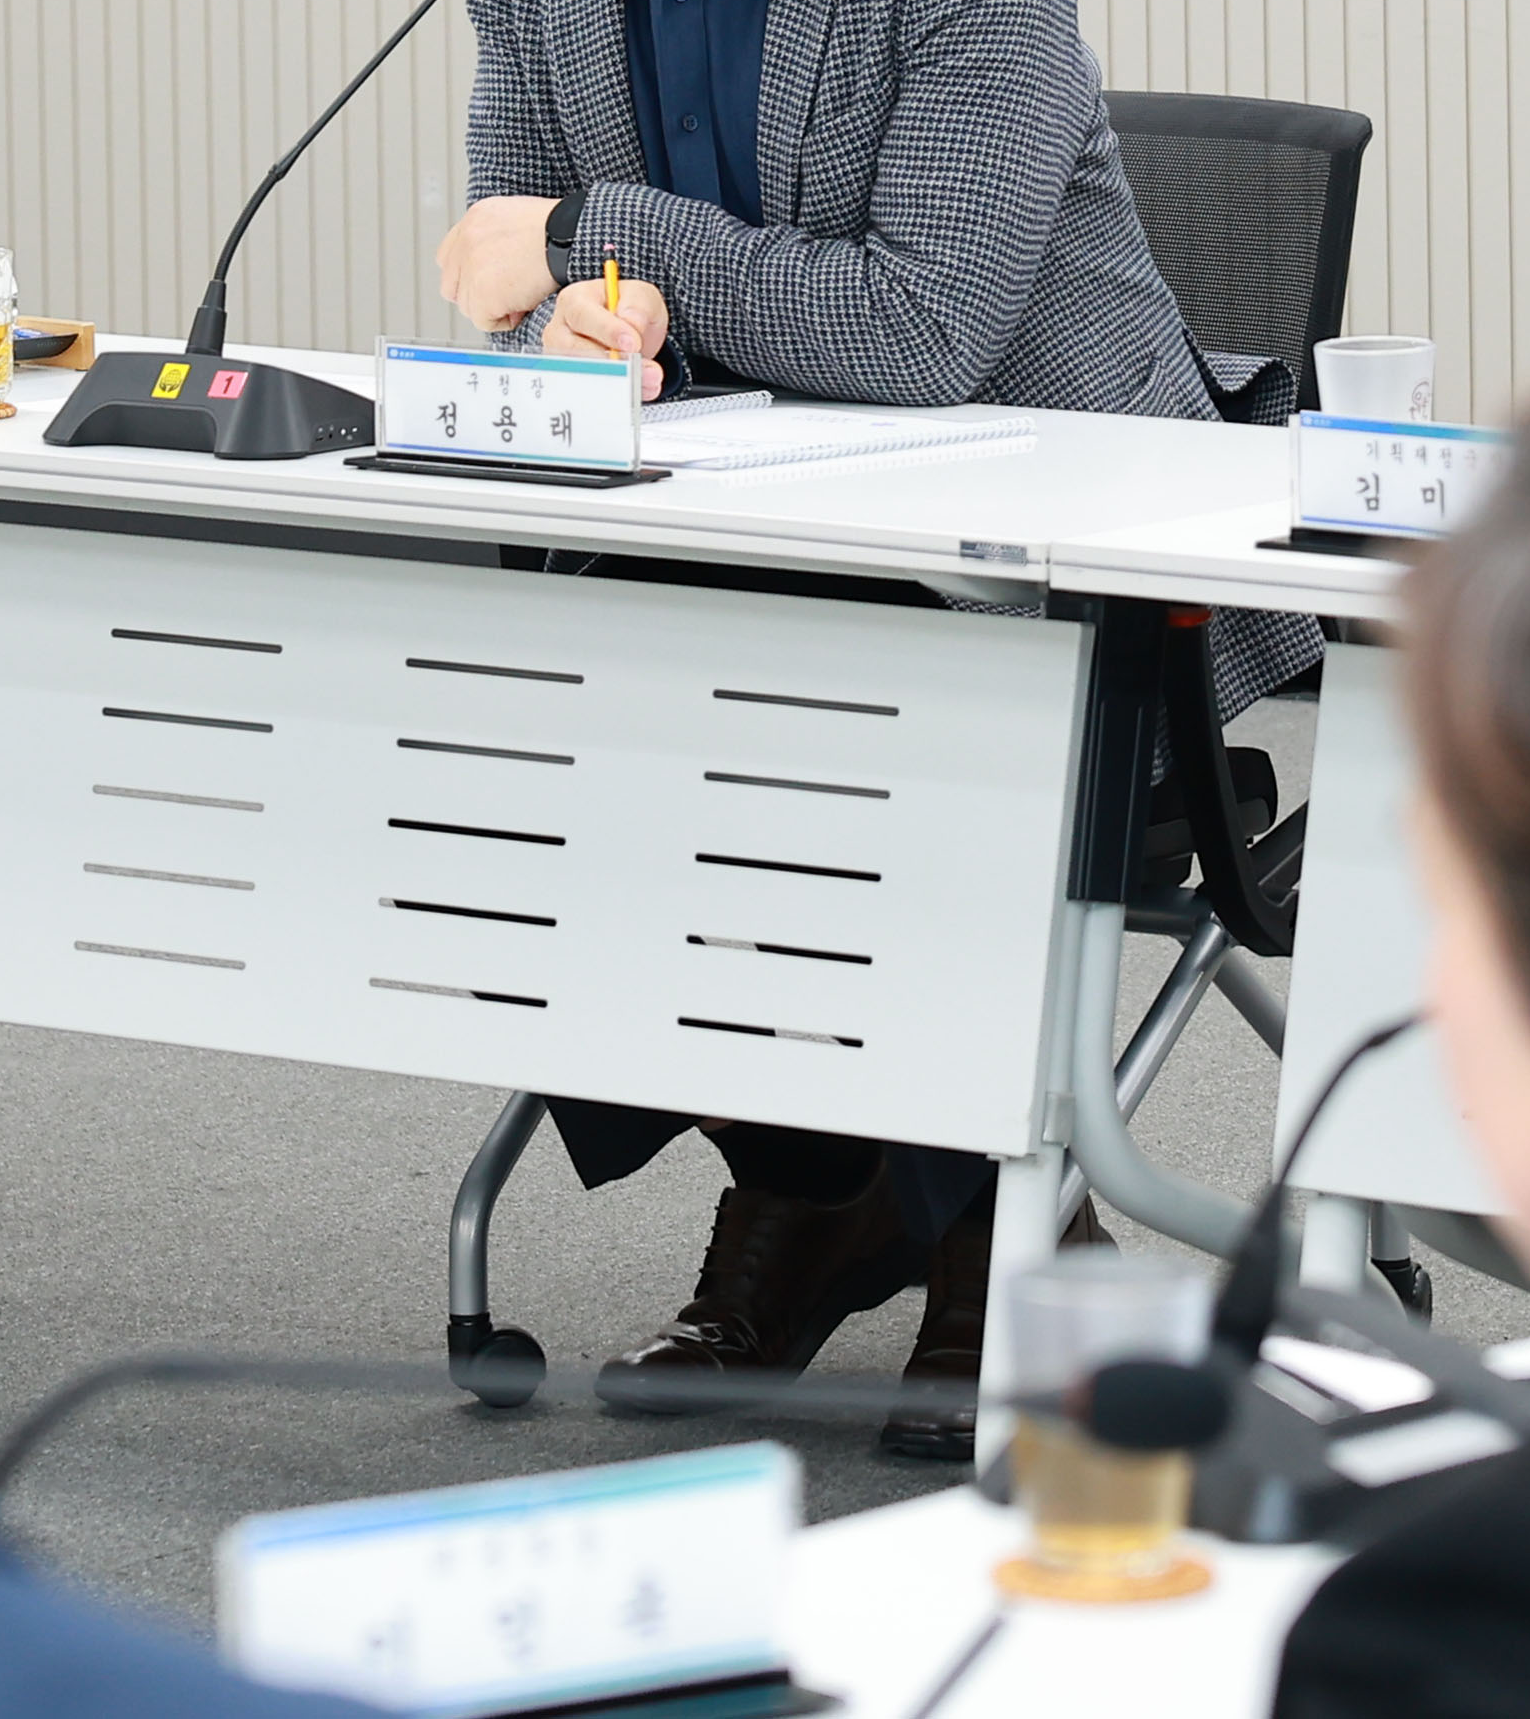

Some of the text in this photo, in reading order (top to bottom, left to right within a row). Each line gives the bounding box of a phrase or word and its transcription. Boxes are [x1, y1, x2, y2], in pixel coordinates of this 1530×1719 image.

[222, 375, 234, 394] 1
[466, 371, 544, 399] 구청장
[435, 400, 573, 449] 정용래
[1355, 472, 1446, 520] 김미
